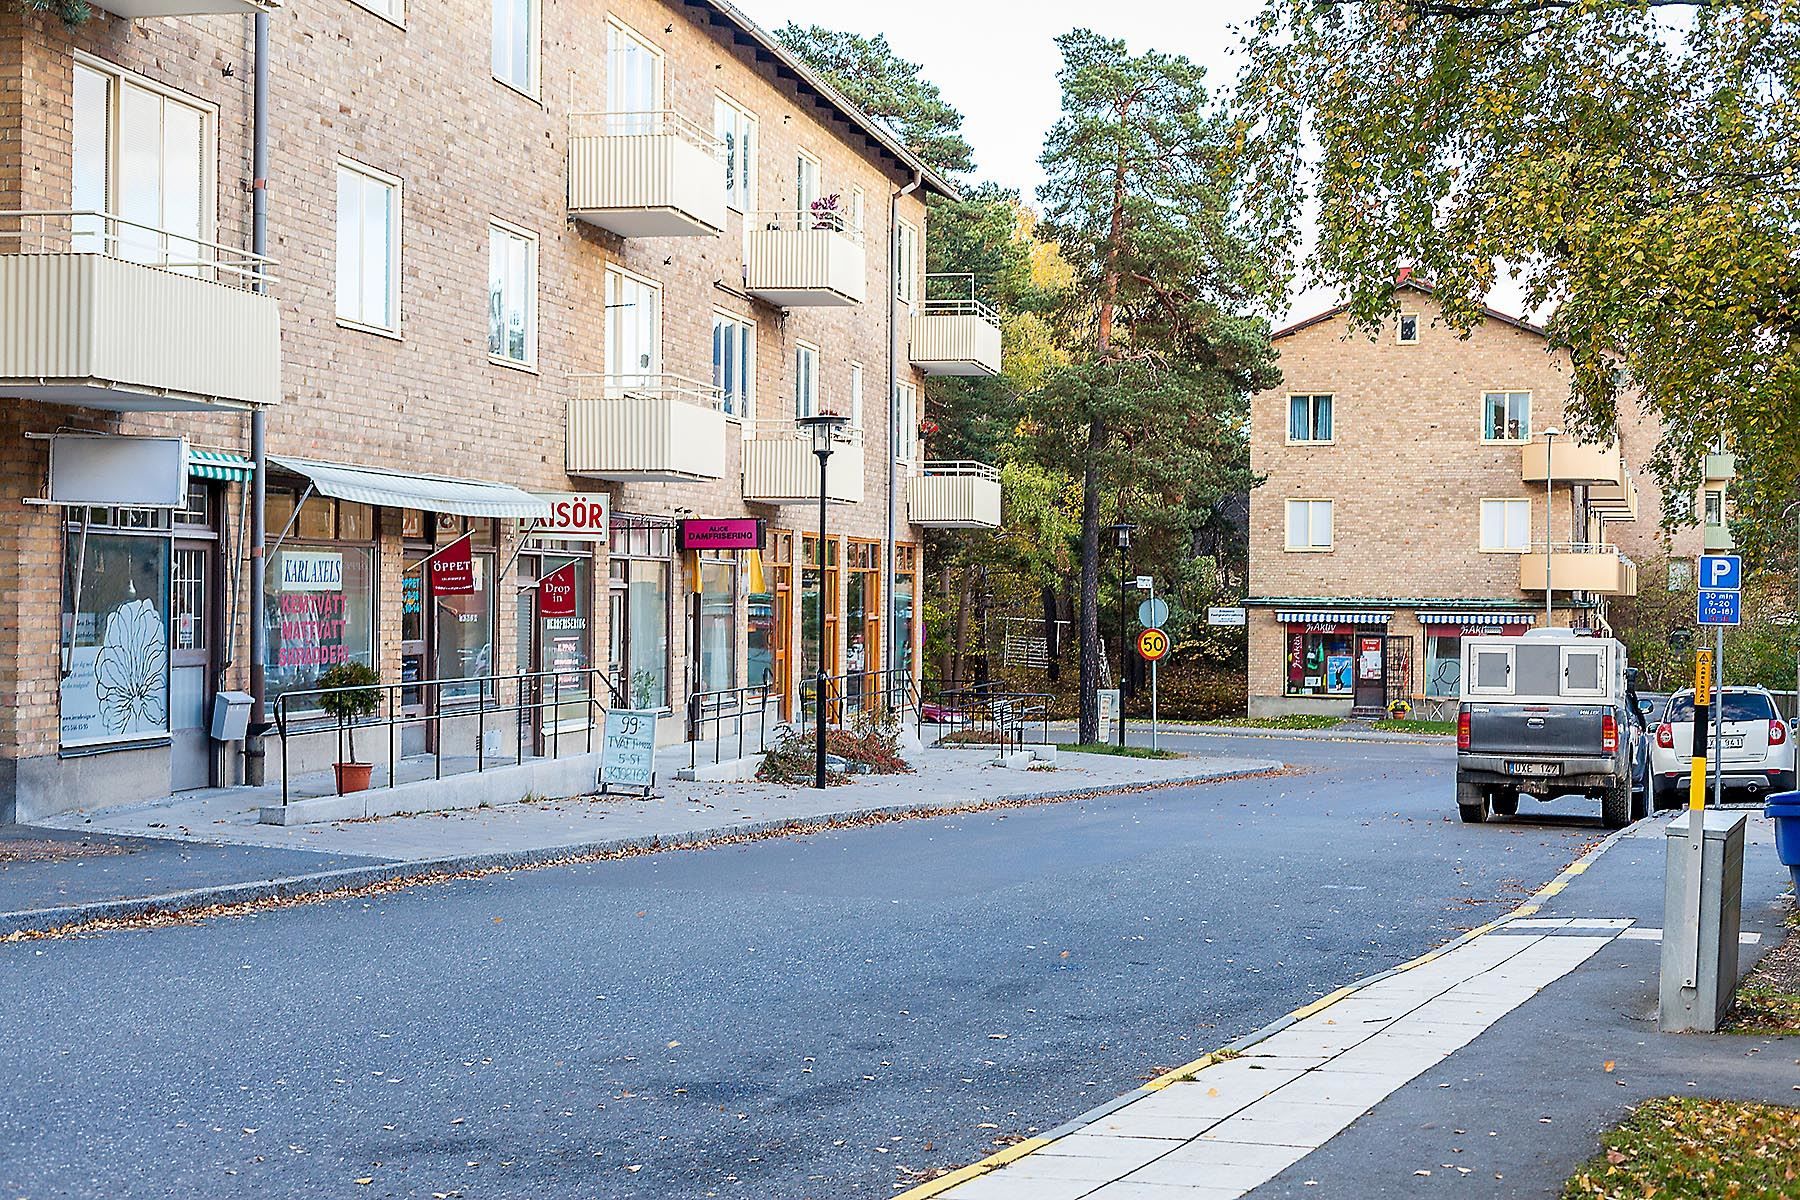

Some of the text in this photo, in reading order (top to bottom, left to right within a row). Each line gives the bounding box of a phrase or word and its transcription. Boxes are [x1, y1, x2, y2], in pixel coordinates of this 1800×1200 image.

[688, 532, 753, 540] DAMFRISERING
[433, 560, 471, 572] ÖPPET
[1711, 559, 1731, 586] P
[545, 583, 571, 595] Drop
[280, 589, 348, 614] KEMTVÄTT
[552, 593, 563, 603] in
[1704, 607, 1734, 615] (10-18)
[281, 612, 347, 640] MATTVÄTT
[1143, 636, 1164, 653] 50
[279, 640, 349, 666] SKRÄDDERI
